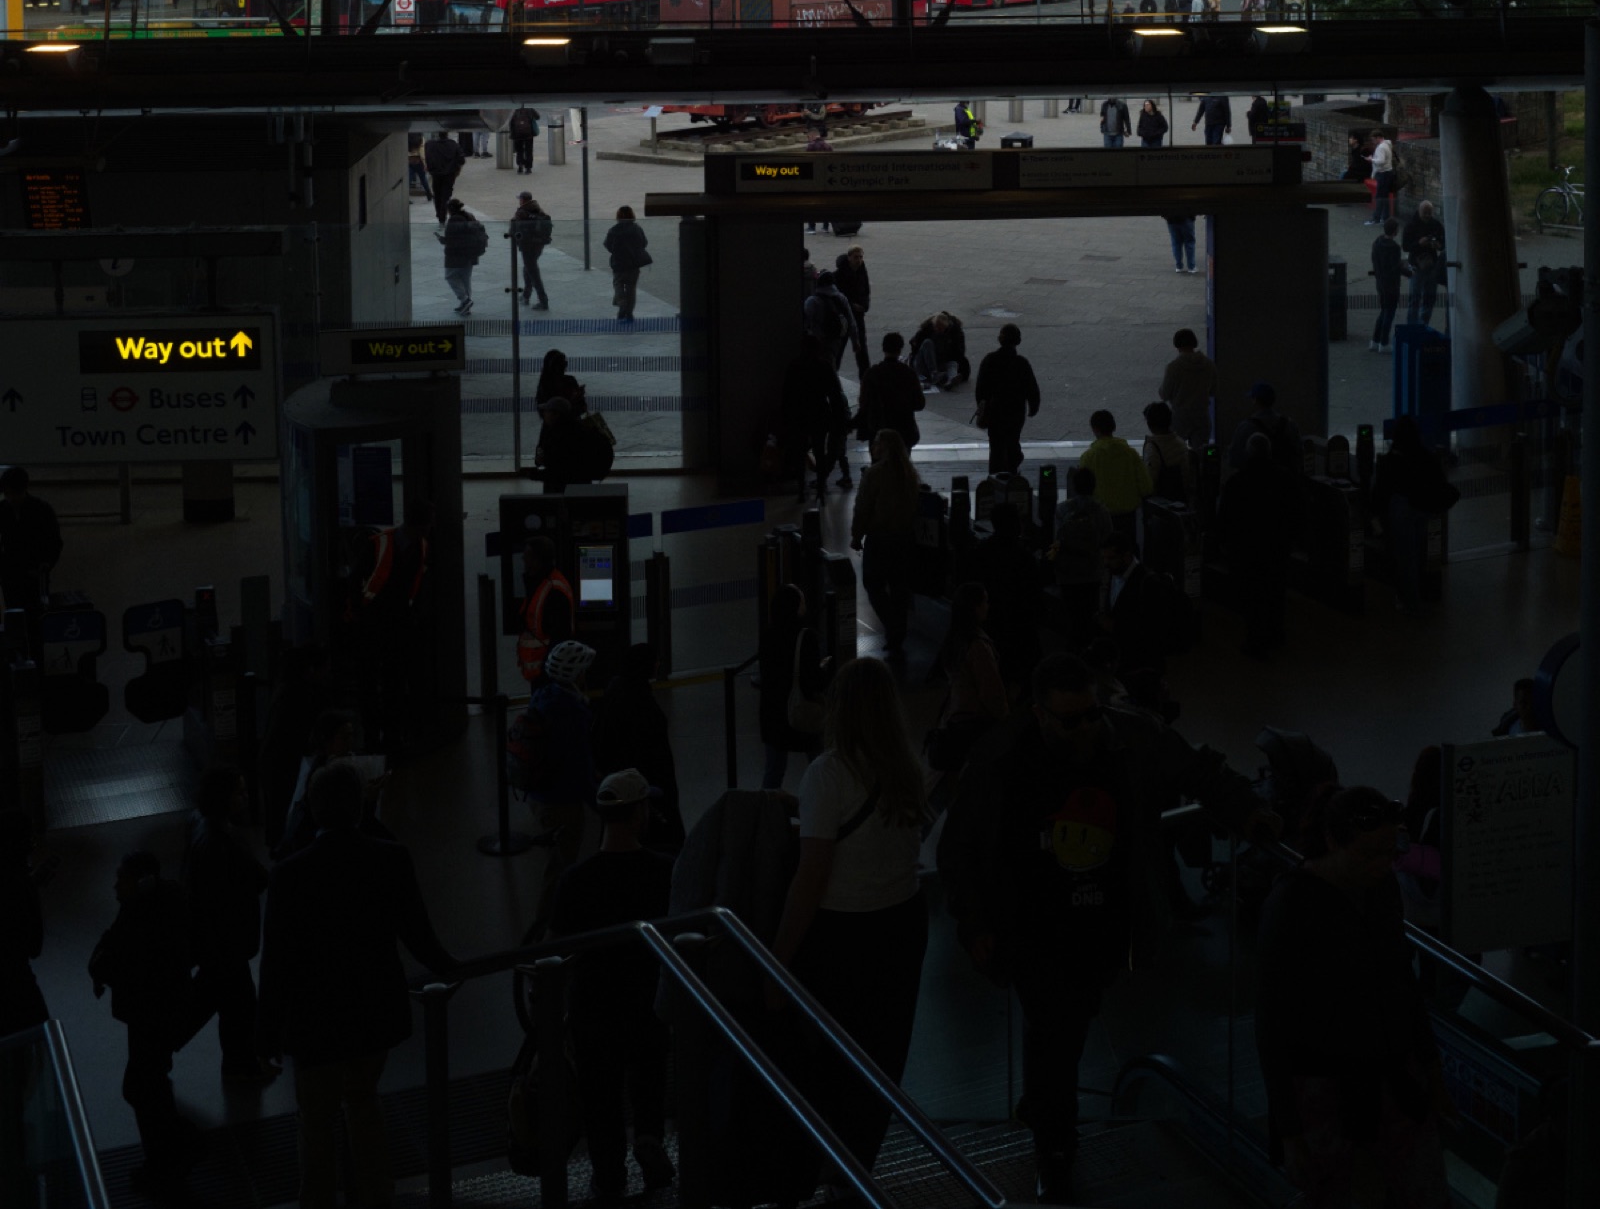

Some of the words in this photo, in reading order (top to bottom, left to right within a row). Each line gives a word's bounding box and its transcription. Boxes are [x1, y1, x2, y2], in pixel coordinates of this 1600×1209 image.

[755, 164, 778, 178] Way
[779, 165, 800, 175] out
[839, 162, 889, 173] Stratford
[891, 161, 961, 173] International
[839, 175, 885, 188] Olympic
[888, 175, 911, 185] Park
[115, 336, 174, 365] Way
[179, 336, 228, 359] out
[368, 342, 404, 358] Way
[407, 341, 436, 354] out
[149, 387, 228, 410] Buses
[55, 426, 127, 447] Town
[136, 423, 229, 446] Centre
[1071, 891, 1105, 907] DNB
